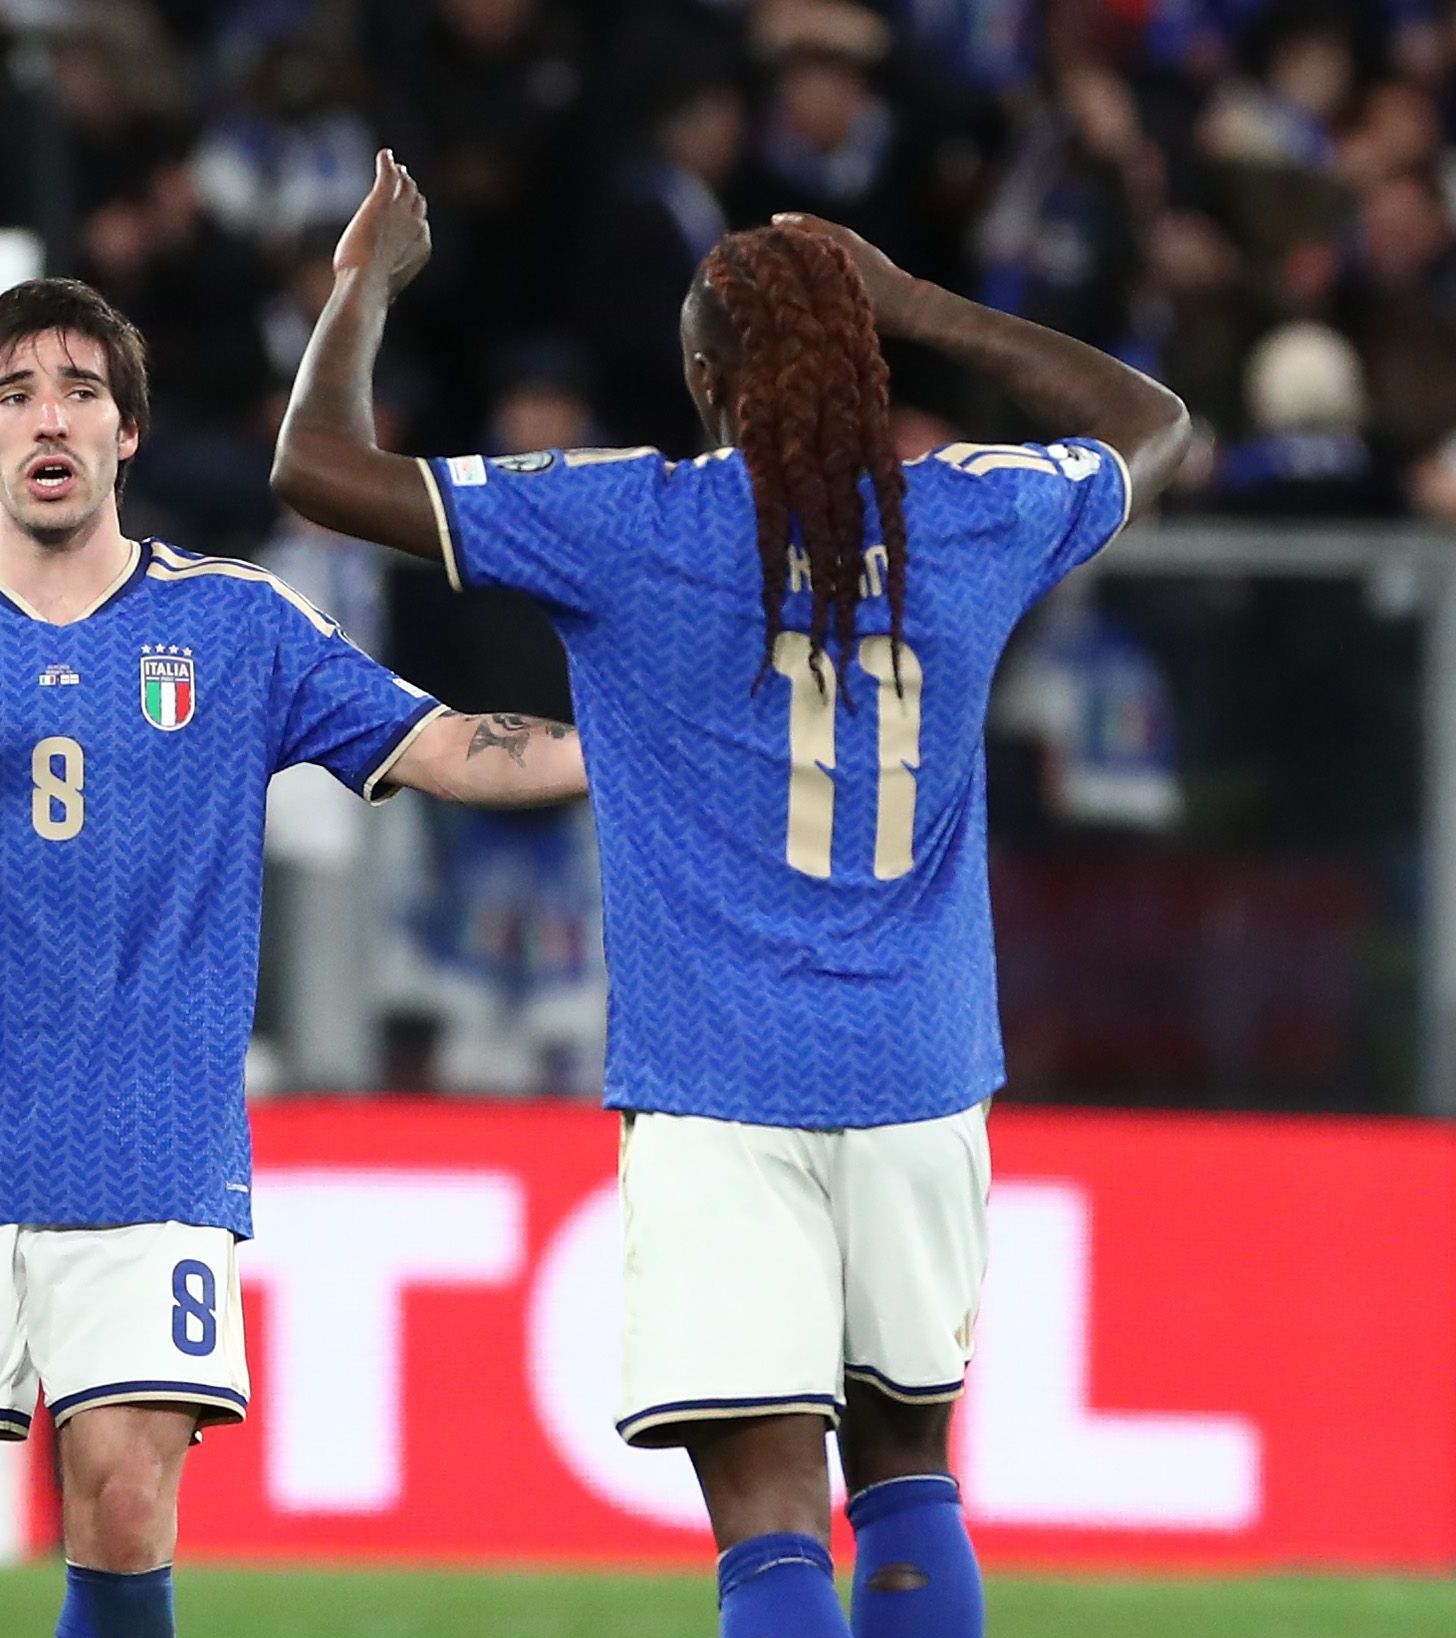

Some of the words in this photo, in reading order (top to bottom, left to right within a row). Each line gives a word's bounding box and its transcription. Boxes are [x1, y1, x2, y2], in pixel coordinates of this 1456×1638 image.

[145, 661, 189, 677] ITALIA
[32, 736, 84, 841] 8
[772, 630, 923, 880] 11
[171, 1259, 217, 1357] 8
